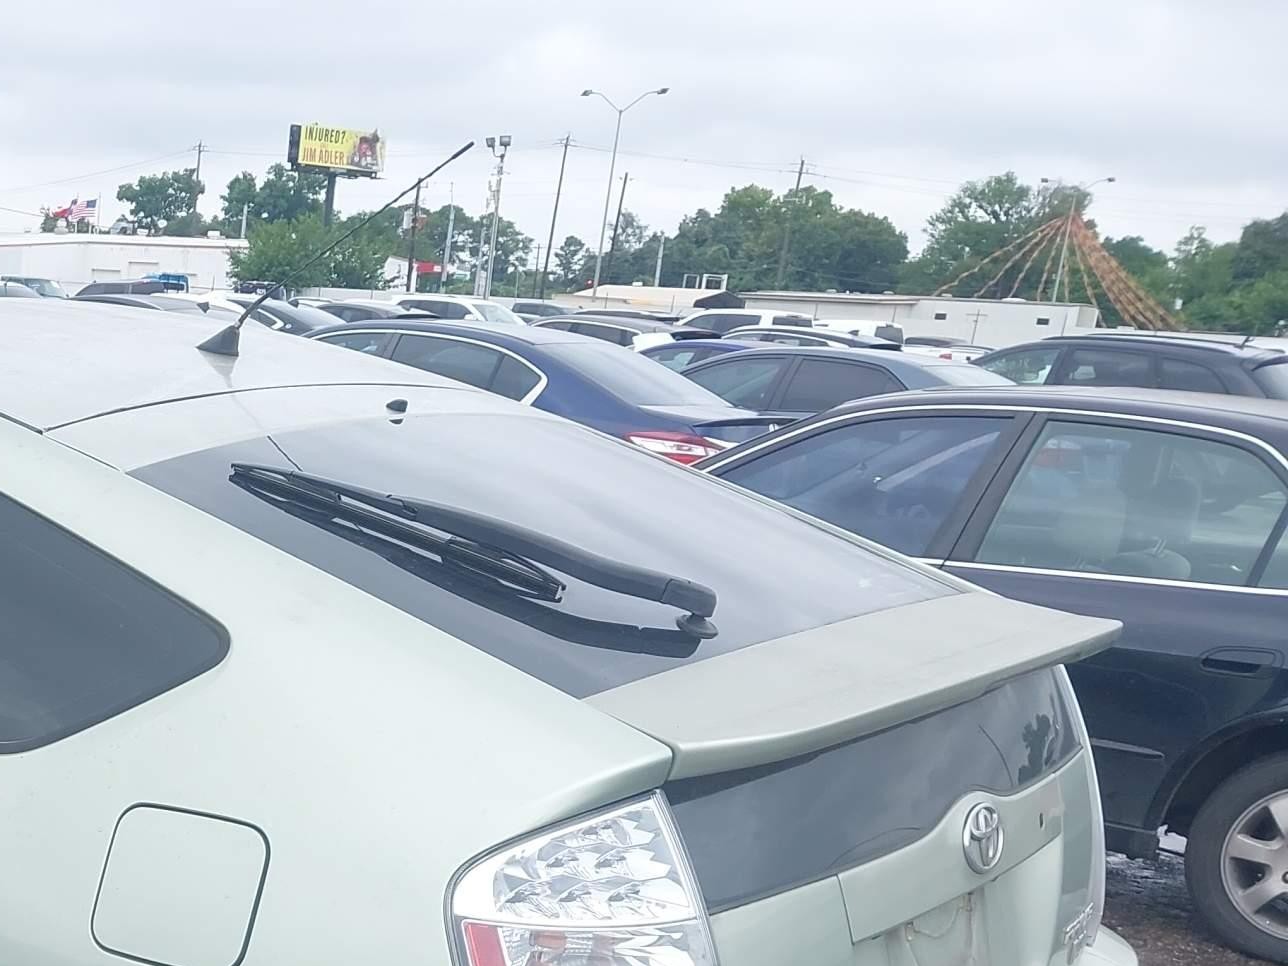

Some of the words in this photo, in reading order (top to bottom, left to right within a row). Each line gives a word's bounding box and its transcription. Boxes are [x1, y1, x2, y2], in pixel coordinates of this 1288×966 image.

[305, 126, 346, 144] INJURED?
[302, 147, 317, 162] JIM
[318, 149, 345, 166] ADLER
